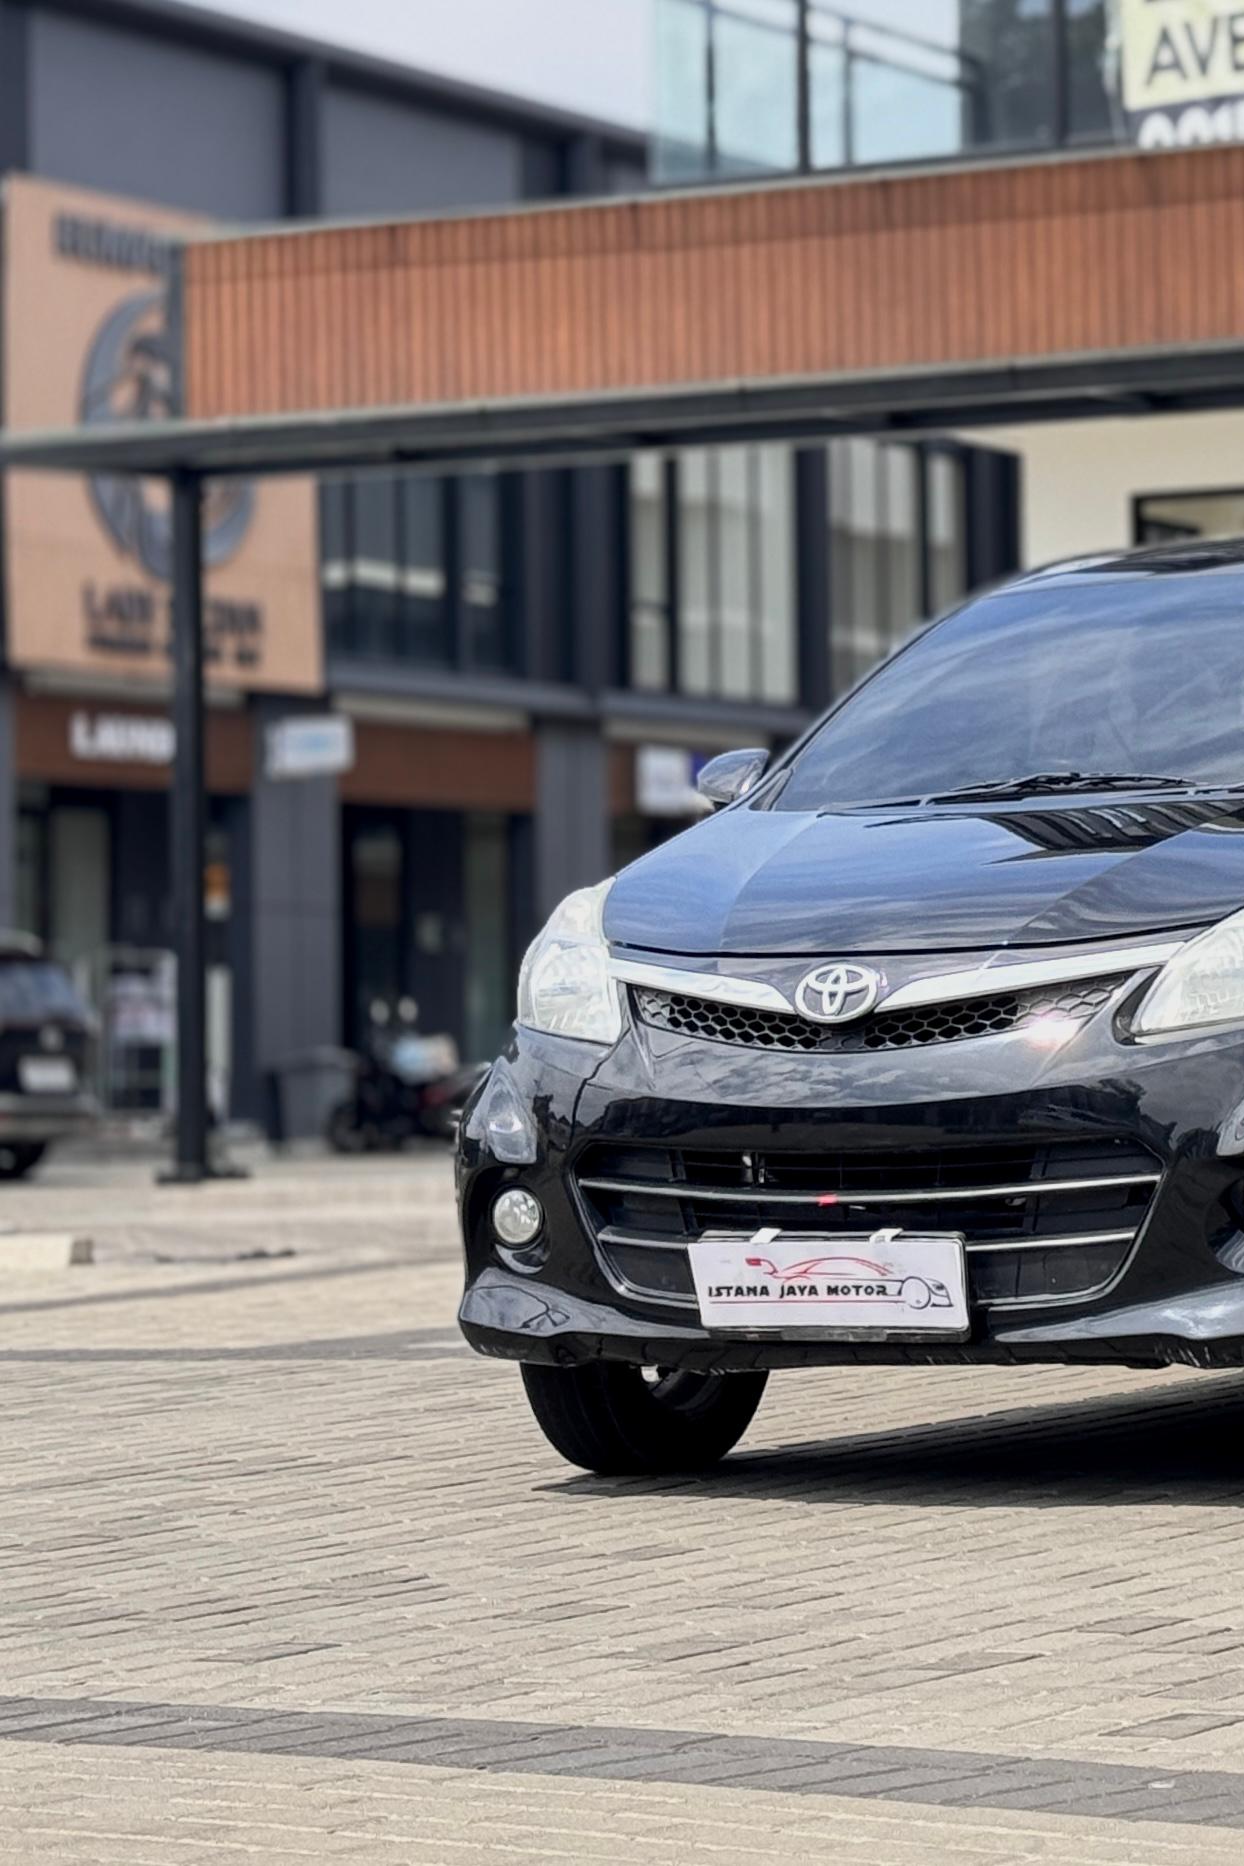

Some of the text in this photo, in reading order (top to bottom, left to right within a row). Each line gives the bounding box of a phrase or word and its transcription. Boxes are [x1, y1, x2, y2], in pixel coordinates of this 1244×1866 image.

[708, 1285, 887, 1298] ISTANA JAYA MOTOR
